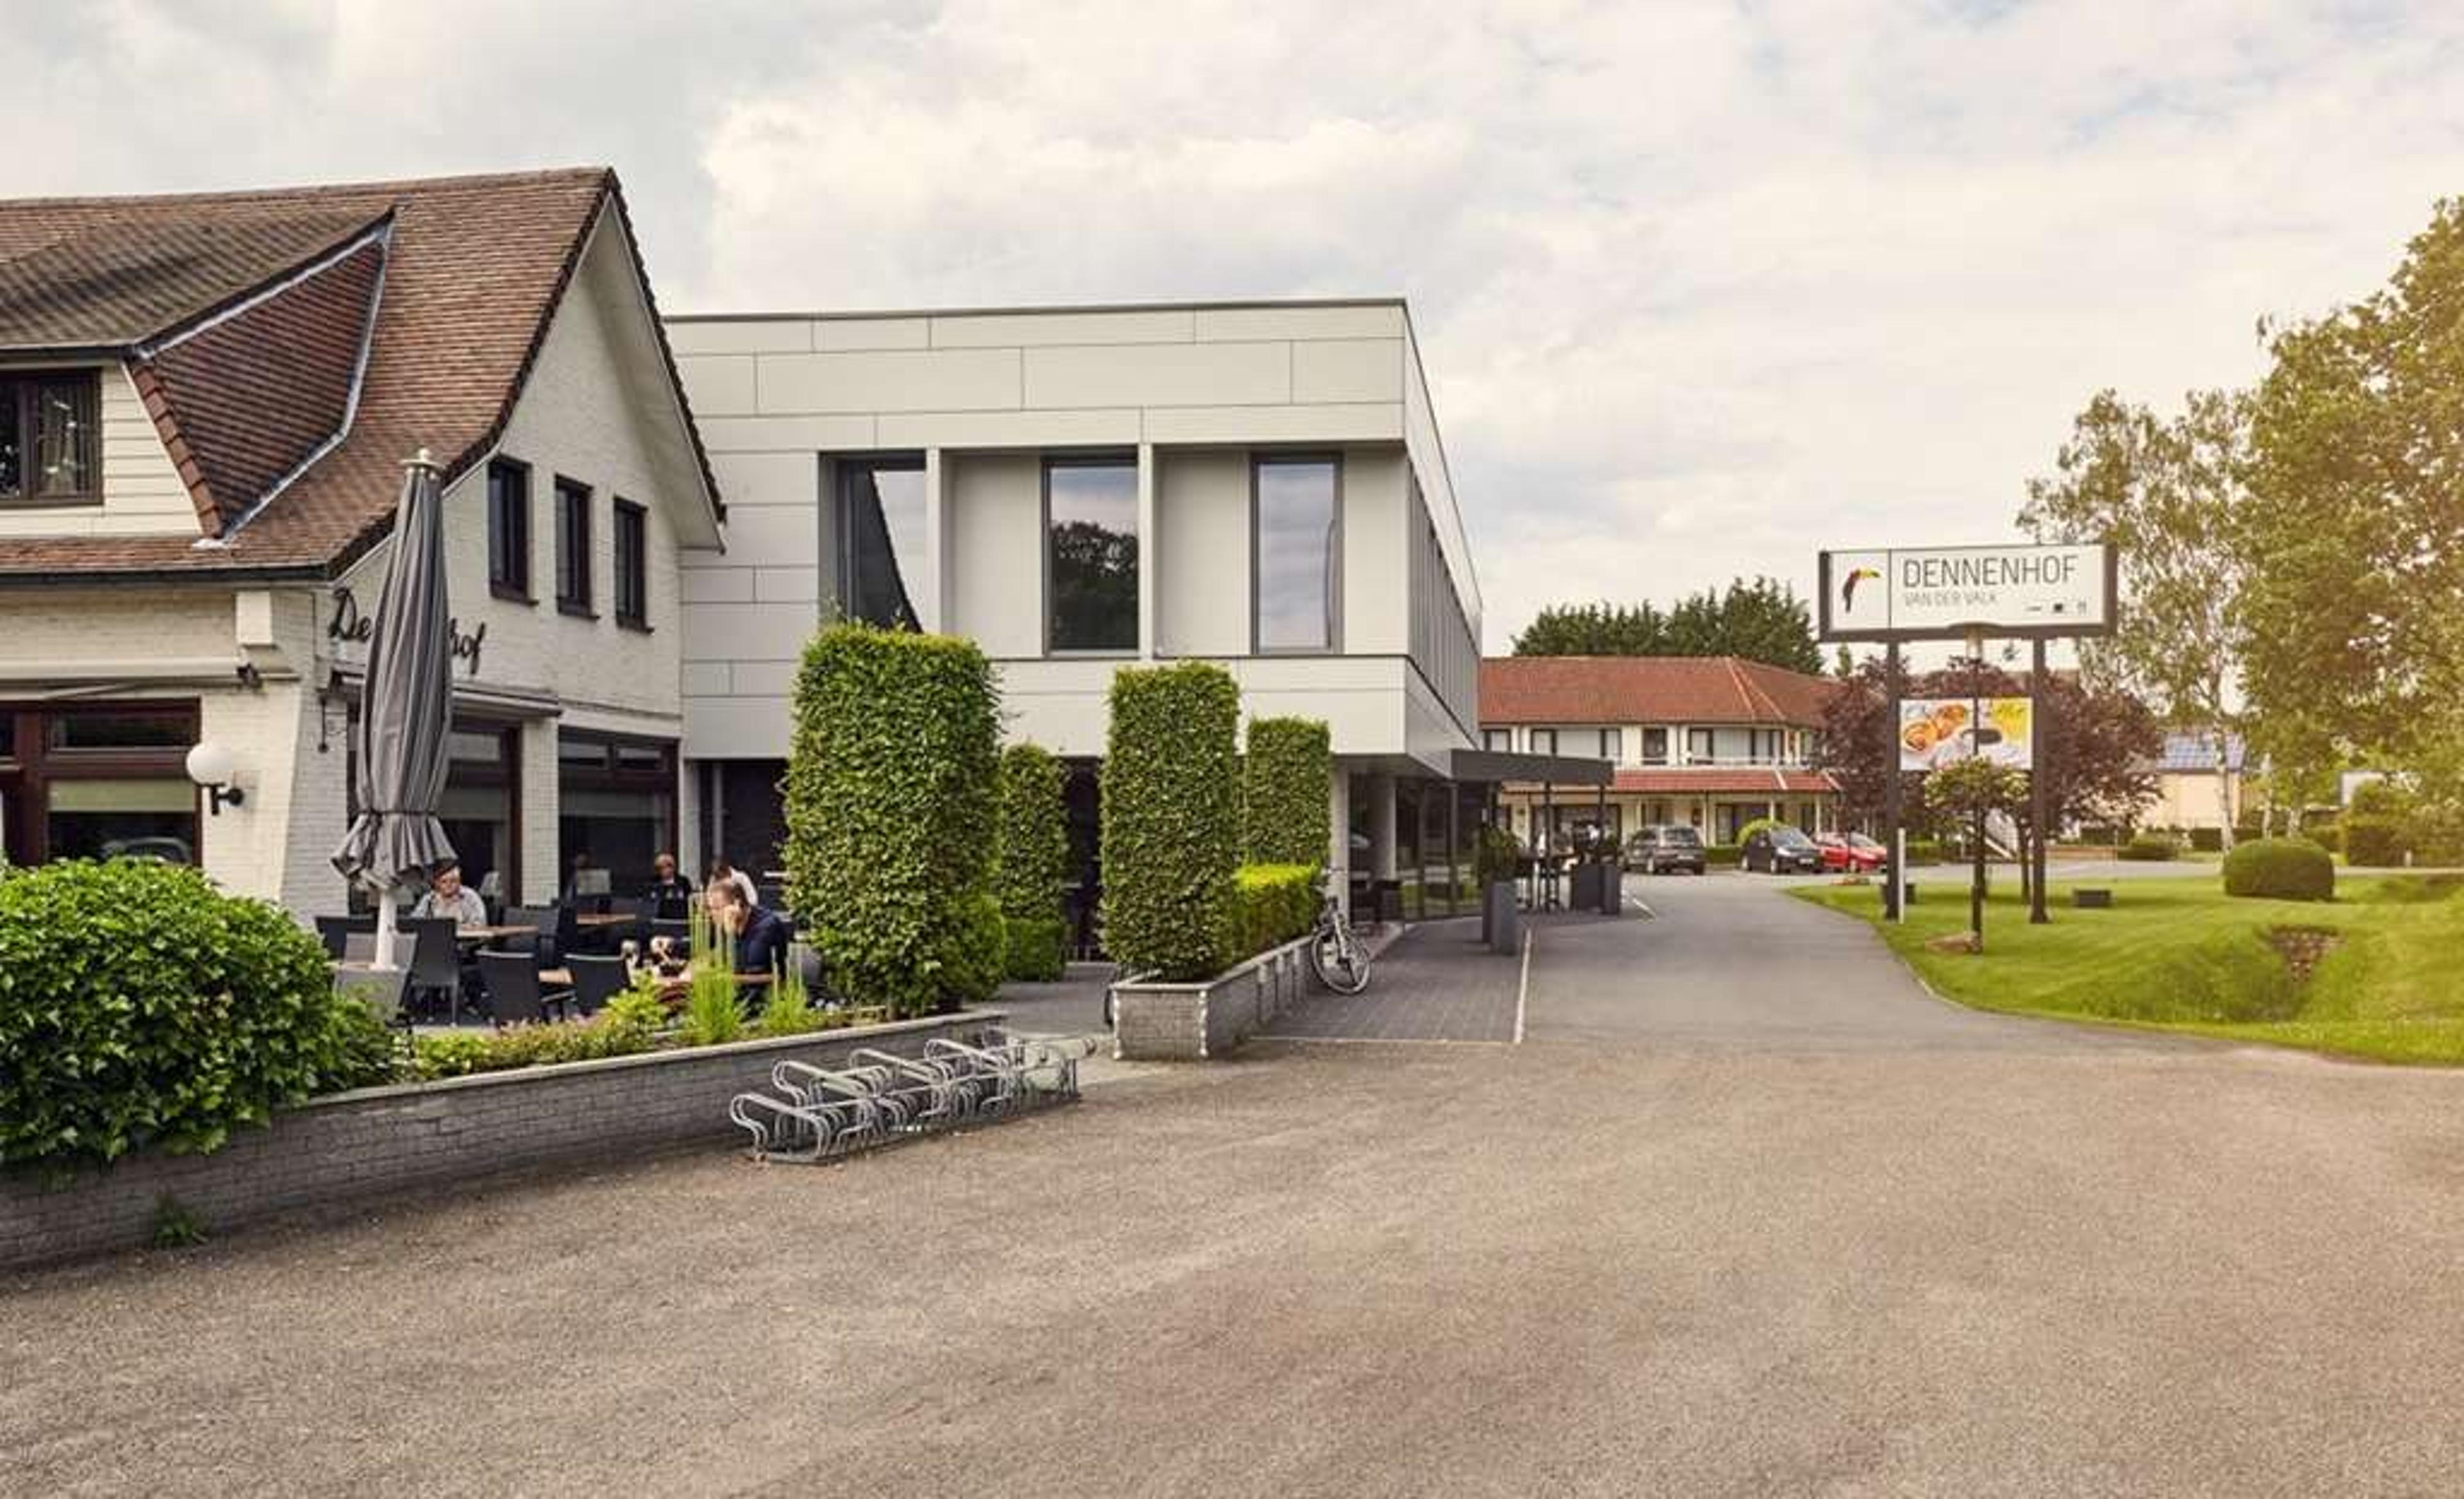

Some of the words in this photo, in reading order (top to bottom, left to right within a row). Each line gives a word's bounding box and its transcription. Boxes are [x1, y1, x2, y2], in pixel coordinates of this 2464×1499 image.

[1903, 555, 2078, 588] DENNENHOF
[1904, 592, 1932, 606] VAN
[1935, 591, 1962, 606] DER
[1964, 590, 1996, 605] VALK
